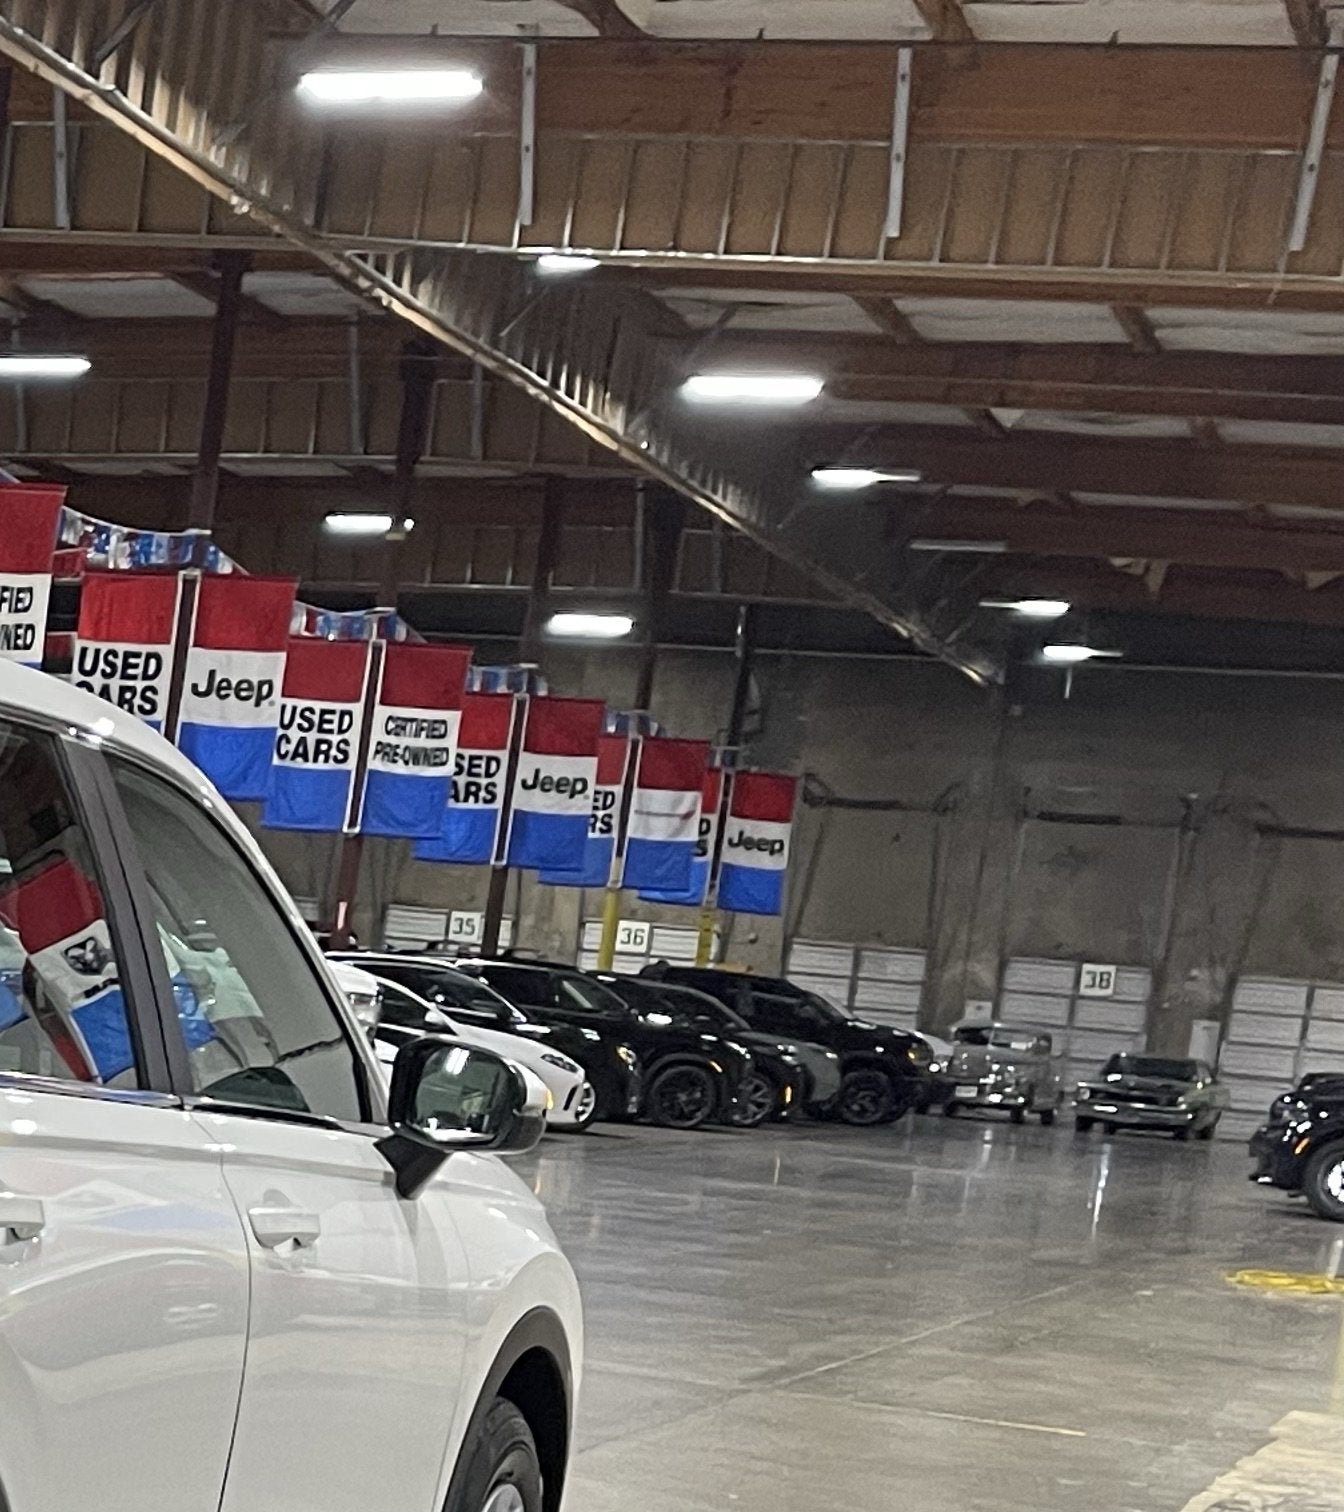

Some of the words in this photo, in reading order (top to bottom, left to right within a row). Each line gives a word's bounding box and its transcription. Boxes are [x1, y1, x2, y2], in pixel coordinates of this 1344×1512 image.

[77, 646, 163, 681] USED
[190, 669, 274, 708] Jeep
[279, 703, 354, 735] USED
[276, 733, 351, 764] CARS
[453, 753, 502, 779] SED
[449, 780, 498, 804] ARS
[520, 768, 589, 800] Jeep
[592, 791, 615, 811] ED
[589, 813, 613, 834] RS
[727, 830, 785, 857] Jeep
[451, 917, 477, 937] 35
[619, 927, 646, 947] 36
